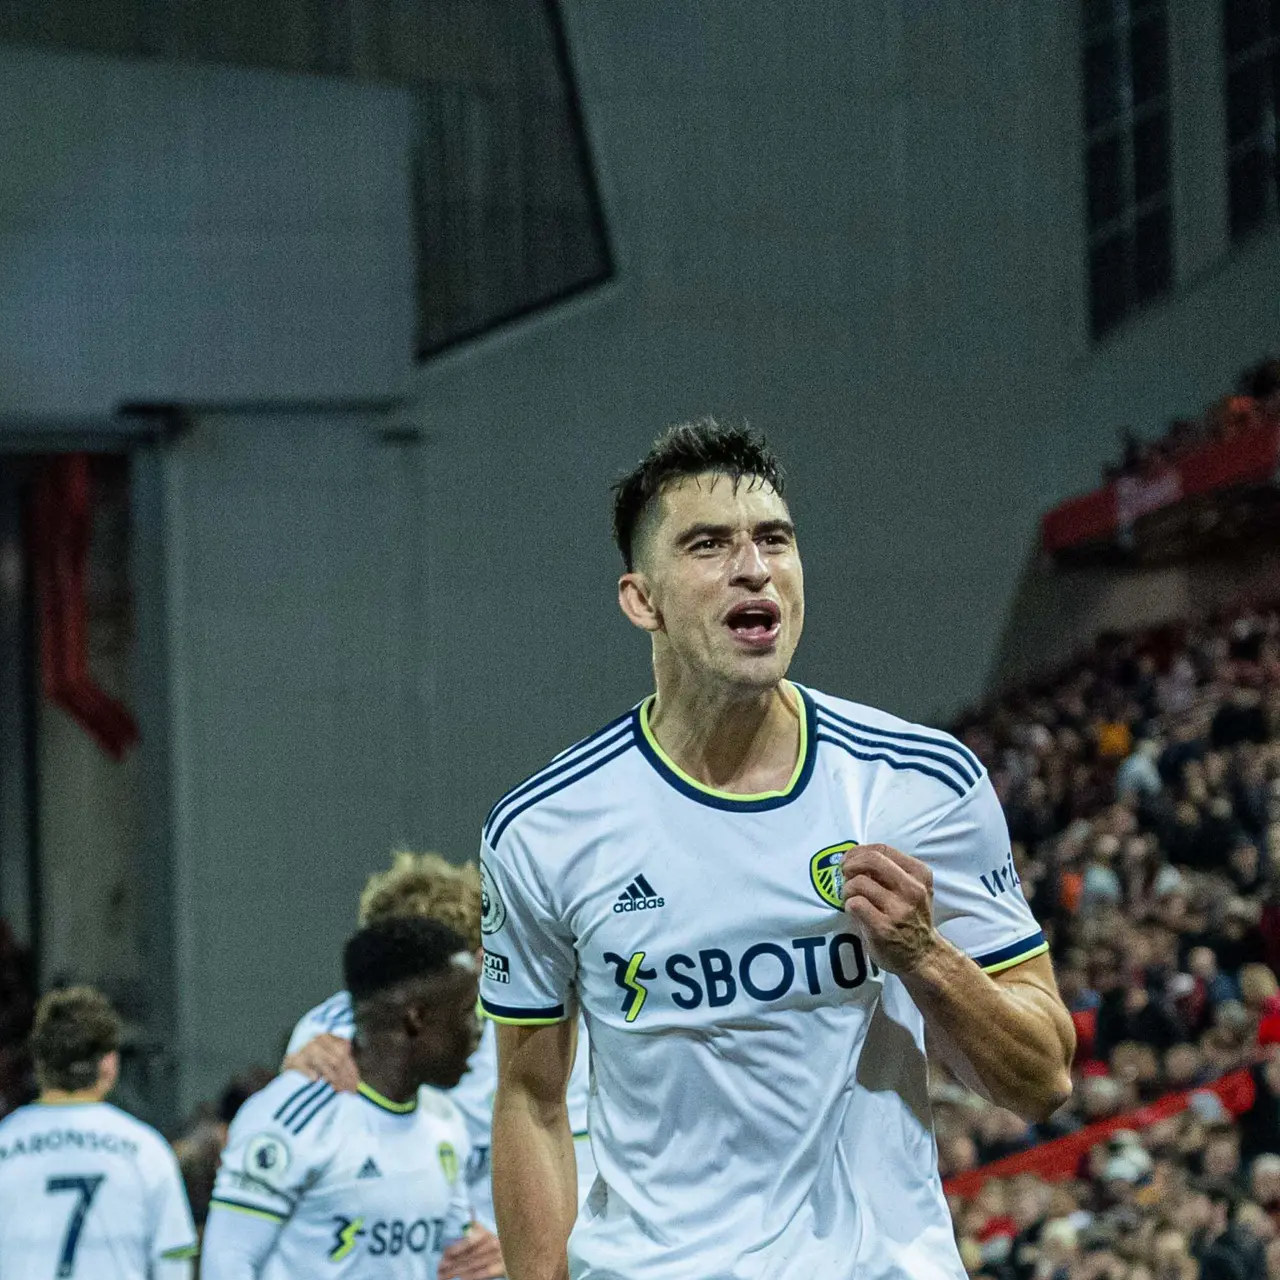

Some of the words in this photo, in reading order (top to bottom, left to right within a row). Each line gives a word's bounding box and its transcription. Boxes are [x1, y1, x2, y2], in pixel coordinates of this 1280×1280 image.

[613, 893, 665, 914] adidas
[664, 932, 880, 1010] SBOTO
[44, 1172, 107, 1280] 7
